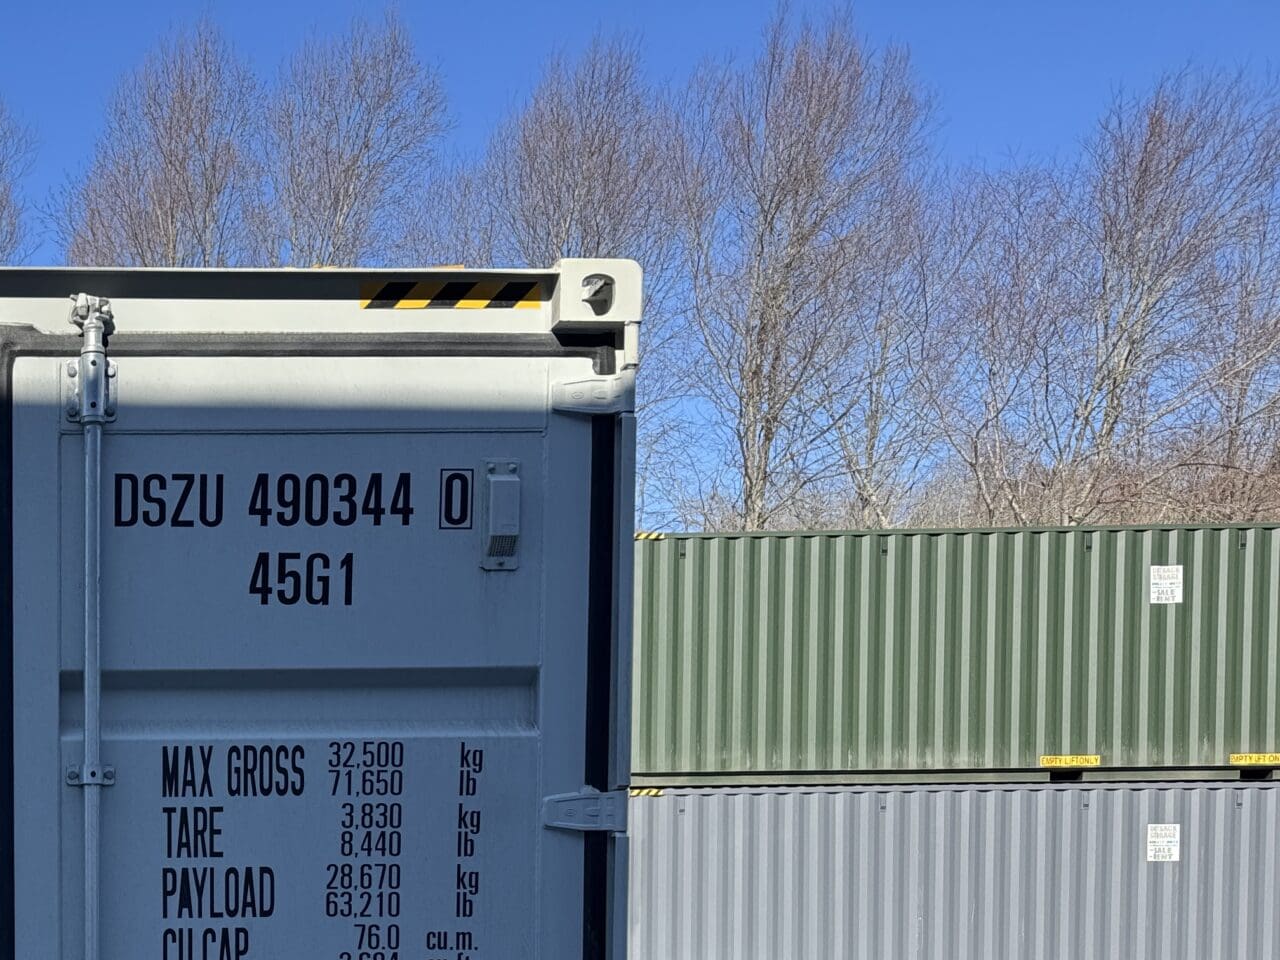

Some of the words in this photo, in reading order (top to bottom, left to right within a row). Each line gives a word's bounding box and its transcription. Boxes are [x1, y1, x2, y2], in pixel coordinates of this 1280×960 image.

[114, 473, 224, 527] DSZU
[248, 472, 414, 527] 490344
[249, 552, 354, 606] 45G1
[162, 745, 214, 798] MAX
[227, 744, 305, 797] GROSS
[328, 741, 404, 769] 32,500
[460, 742, 484, 773] kg
[328, 770, 403, 797] 71,650
[459, 770, 477, 796] lb
[162, 806, 224, 858] TARE
[341, 802, 402, 831] 3,830
[457, 803, 481, 834] kg
[340, 831, 402, 858] 8,440
[457, 831, 475, 857] lb
[162, 866, 275, 919] PAYLOAD
[325, 863, 401, 891] 28,670
[456, 863, 479, 895] kg
[325, 891, 401, 919] 63,210
[455, 892, 473, 918] lb
[354, 924, 400, 951] 76.0
[425, 930, 478, 951] cu.m.
